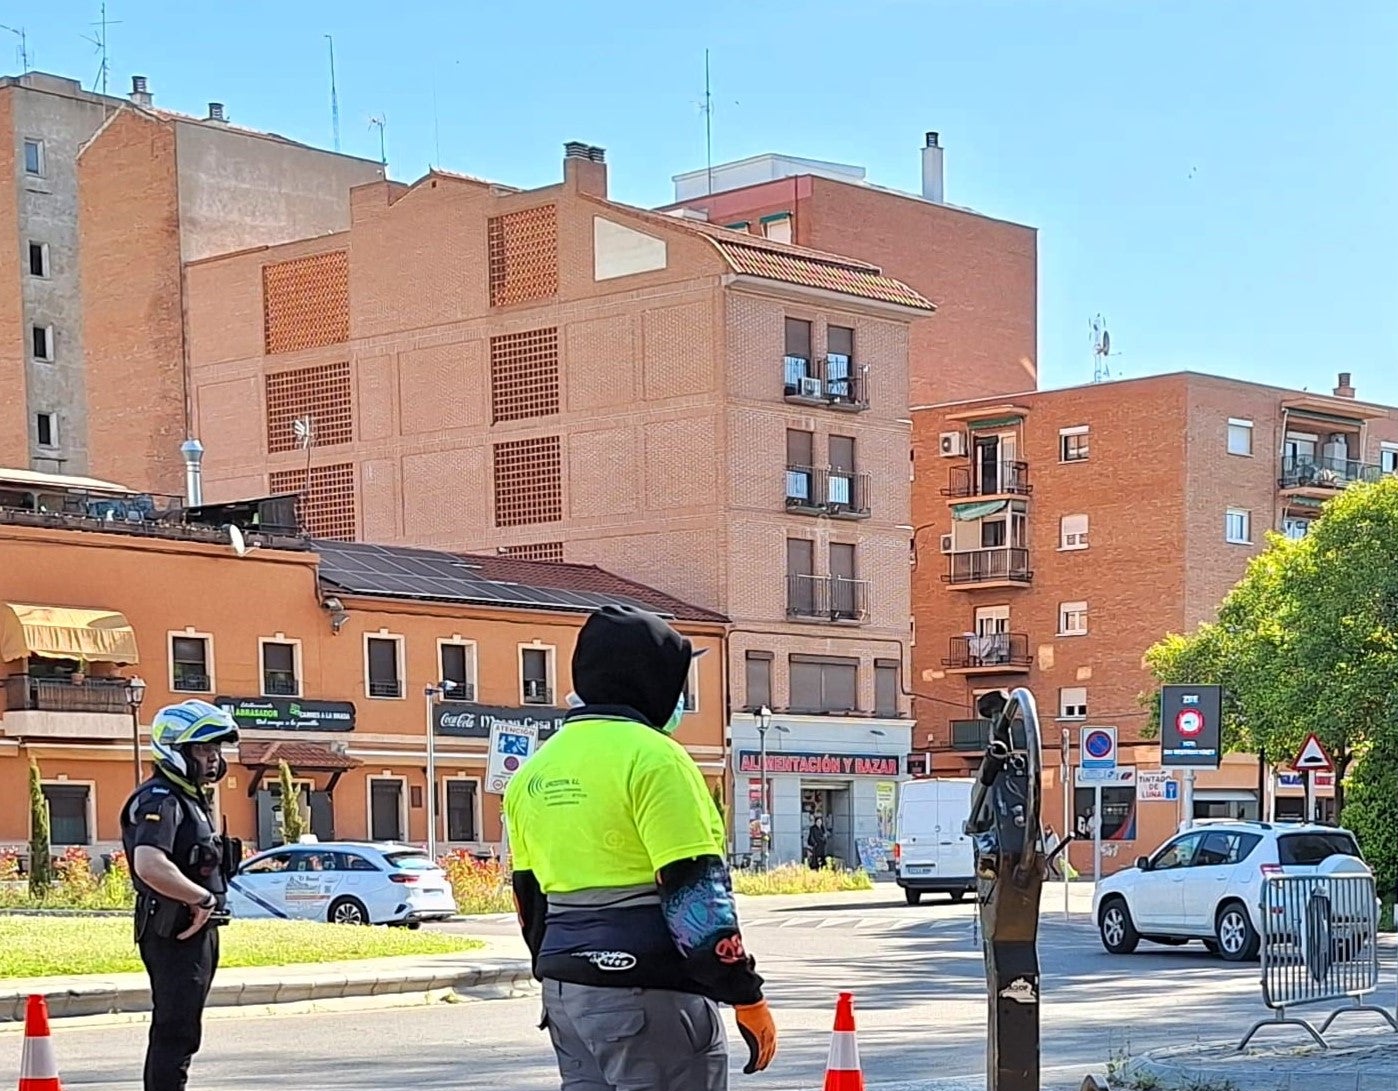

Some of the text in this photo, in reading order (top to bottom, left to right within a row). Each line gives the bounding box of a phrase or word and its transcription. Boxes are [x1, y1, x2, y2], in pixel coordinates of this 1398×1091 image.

[741, 754, 841, 773] ALMENTACIÓN
[843, 757, 851, 774] Y
[855, 758, 897, 775] BAZAR
[1141, 790, 1165, 799] LUNA
